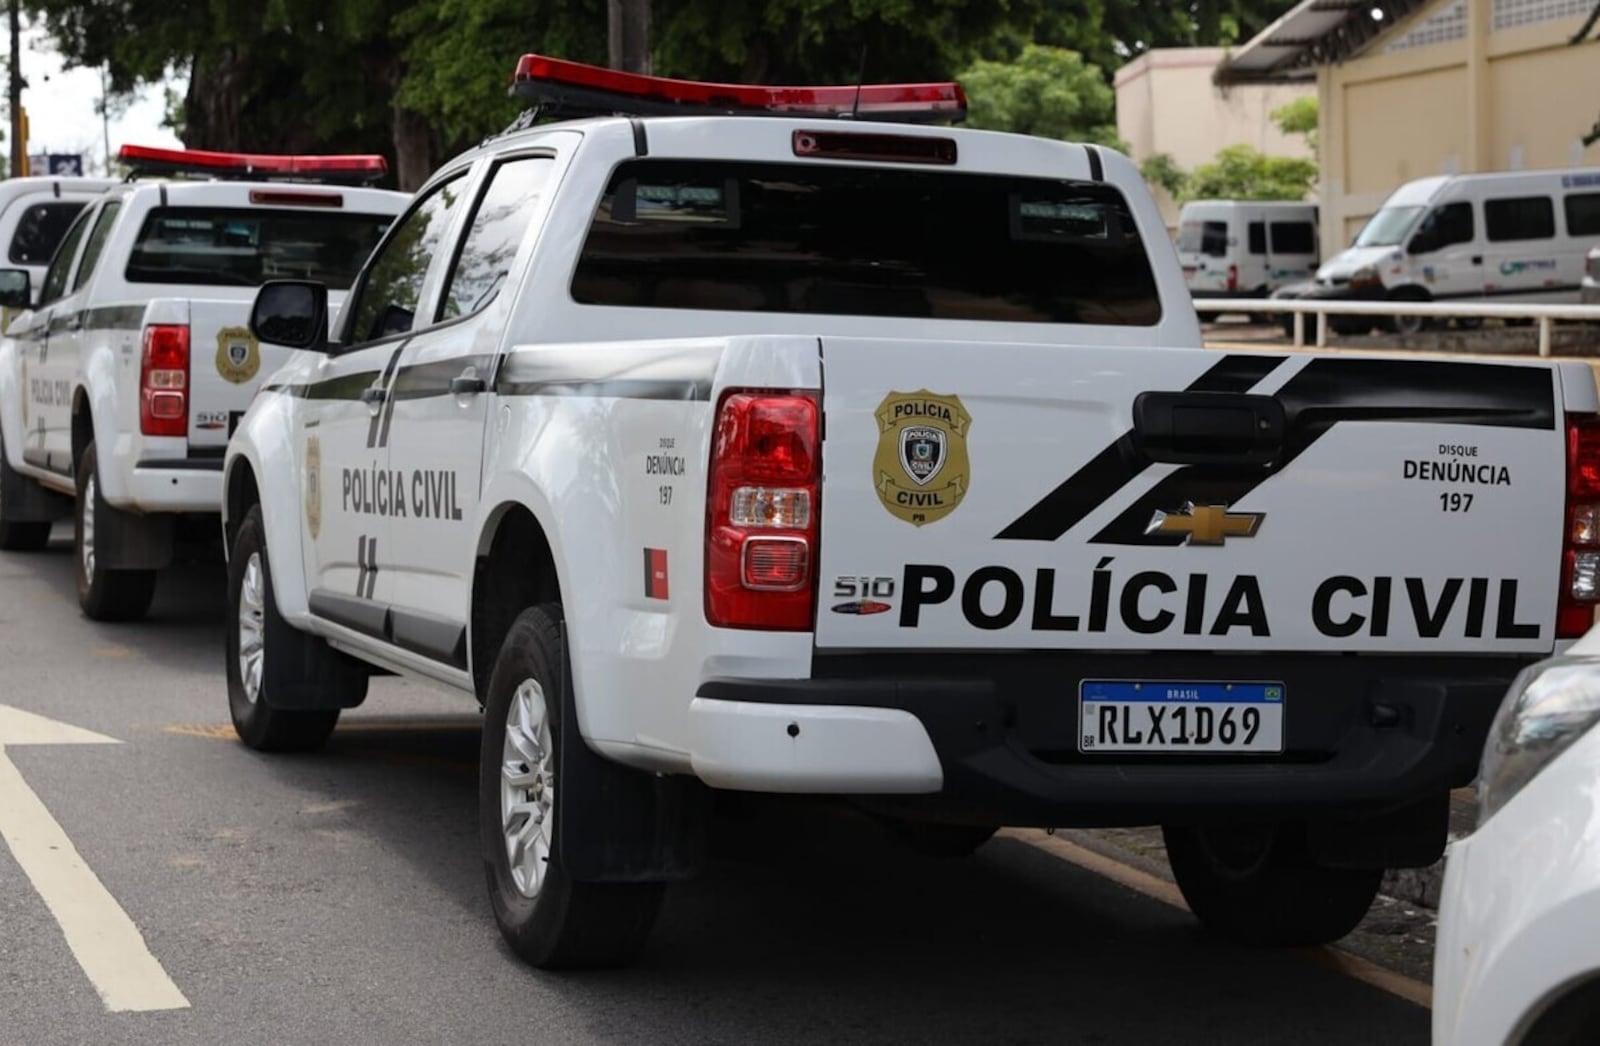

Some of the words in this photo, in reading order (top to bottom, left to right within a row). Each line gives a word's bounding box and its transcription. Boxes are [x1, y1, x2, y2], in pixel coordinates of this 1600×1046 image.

[894, 402, 952, 422] POLÍCIA
[1438, 444, 1478, 457] DISQUE
[647, 451, 685, 476] DENÚNCIA
[1403, 458, 1511, 486] DENÚNCIA
[343, 459, 407, 518] POLÍCIA
[411, 469, 462, 521] CIVIL
[659, 485, 672, 505] 197
[896, 491, 944, 506] CIVIL
[1439, 492, 1474, 512] 197
[834, 576, 895, 598] S10
[899, 556, 1271, 638] POLÍCIA
[1311, 575, 1541, 639] CIVIL
[1166, 689, 1200, 700] BRASIL
[1098, 705, 1261, 745] RLX1D69
[1083, 735, 1095, 748] BR
